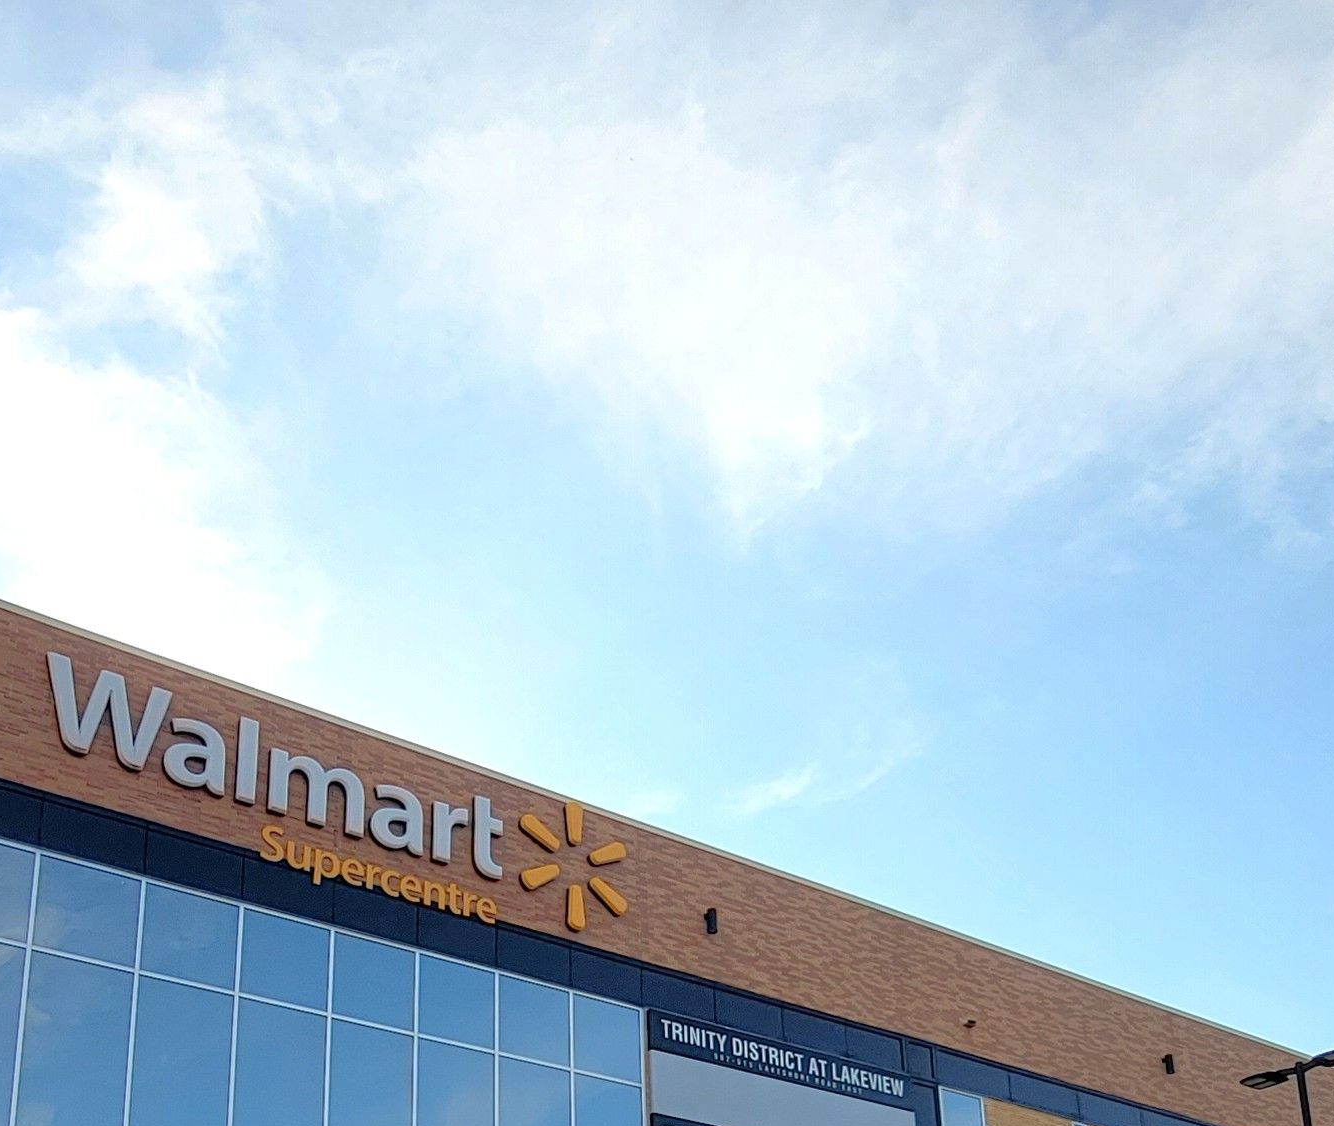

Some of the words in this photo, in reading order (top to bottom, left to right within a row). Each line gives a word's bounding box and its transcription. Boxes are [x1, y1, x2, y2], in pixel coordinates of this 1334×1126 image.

[46, 651, 504, 880] Walmart
[259, 825, 498, 925] Supercentre
[661, 1018, 727, 1053] TRINITY
[732, 1036, 804, 1073] DISTRICT
[809, 1057, 828, 1078] AT
[831, 1062, 905, 1098] LAKEVIEW
